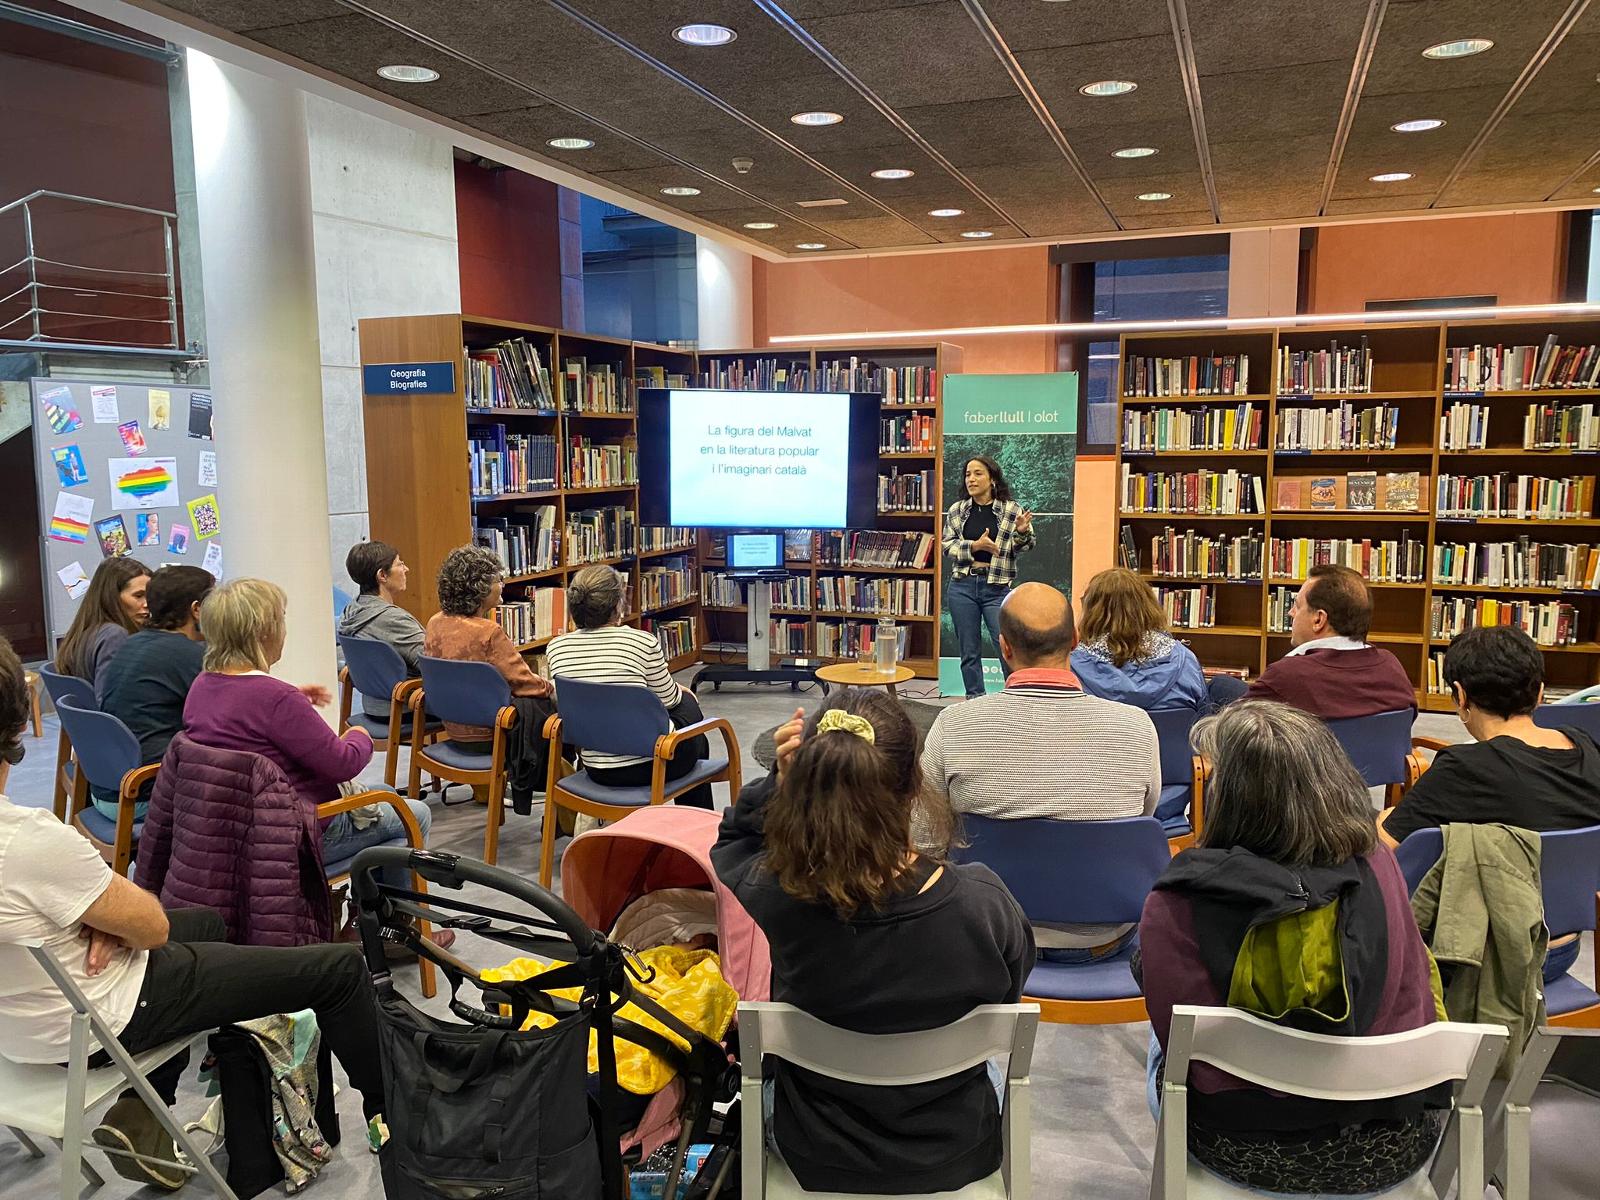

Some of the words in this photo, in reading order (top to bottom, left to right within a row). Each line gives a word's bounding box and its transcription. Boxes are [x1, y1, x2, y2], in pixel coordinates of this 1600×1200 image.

[390, 369, 426, 379] Geografia
[390, 381, 428, 390] Biografies
[963, 410, 1024, 424] faberllull
[1034, 410, 1059, 423] olot
[708, 424, 721, 436] La
[724, 425, 755, 438] figura
[757, 425, 774, 437] del
[776, 426, 812, 437] Malvat
[700, 445, 714, 454] en
[717, 444, 726, 455] la
[729, 445, 775, 456] literatura
[778, 446, 820, 458] popular
[718, 463, 772, 476] l'imaginari
[774, 465, 807, 476] català
